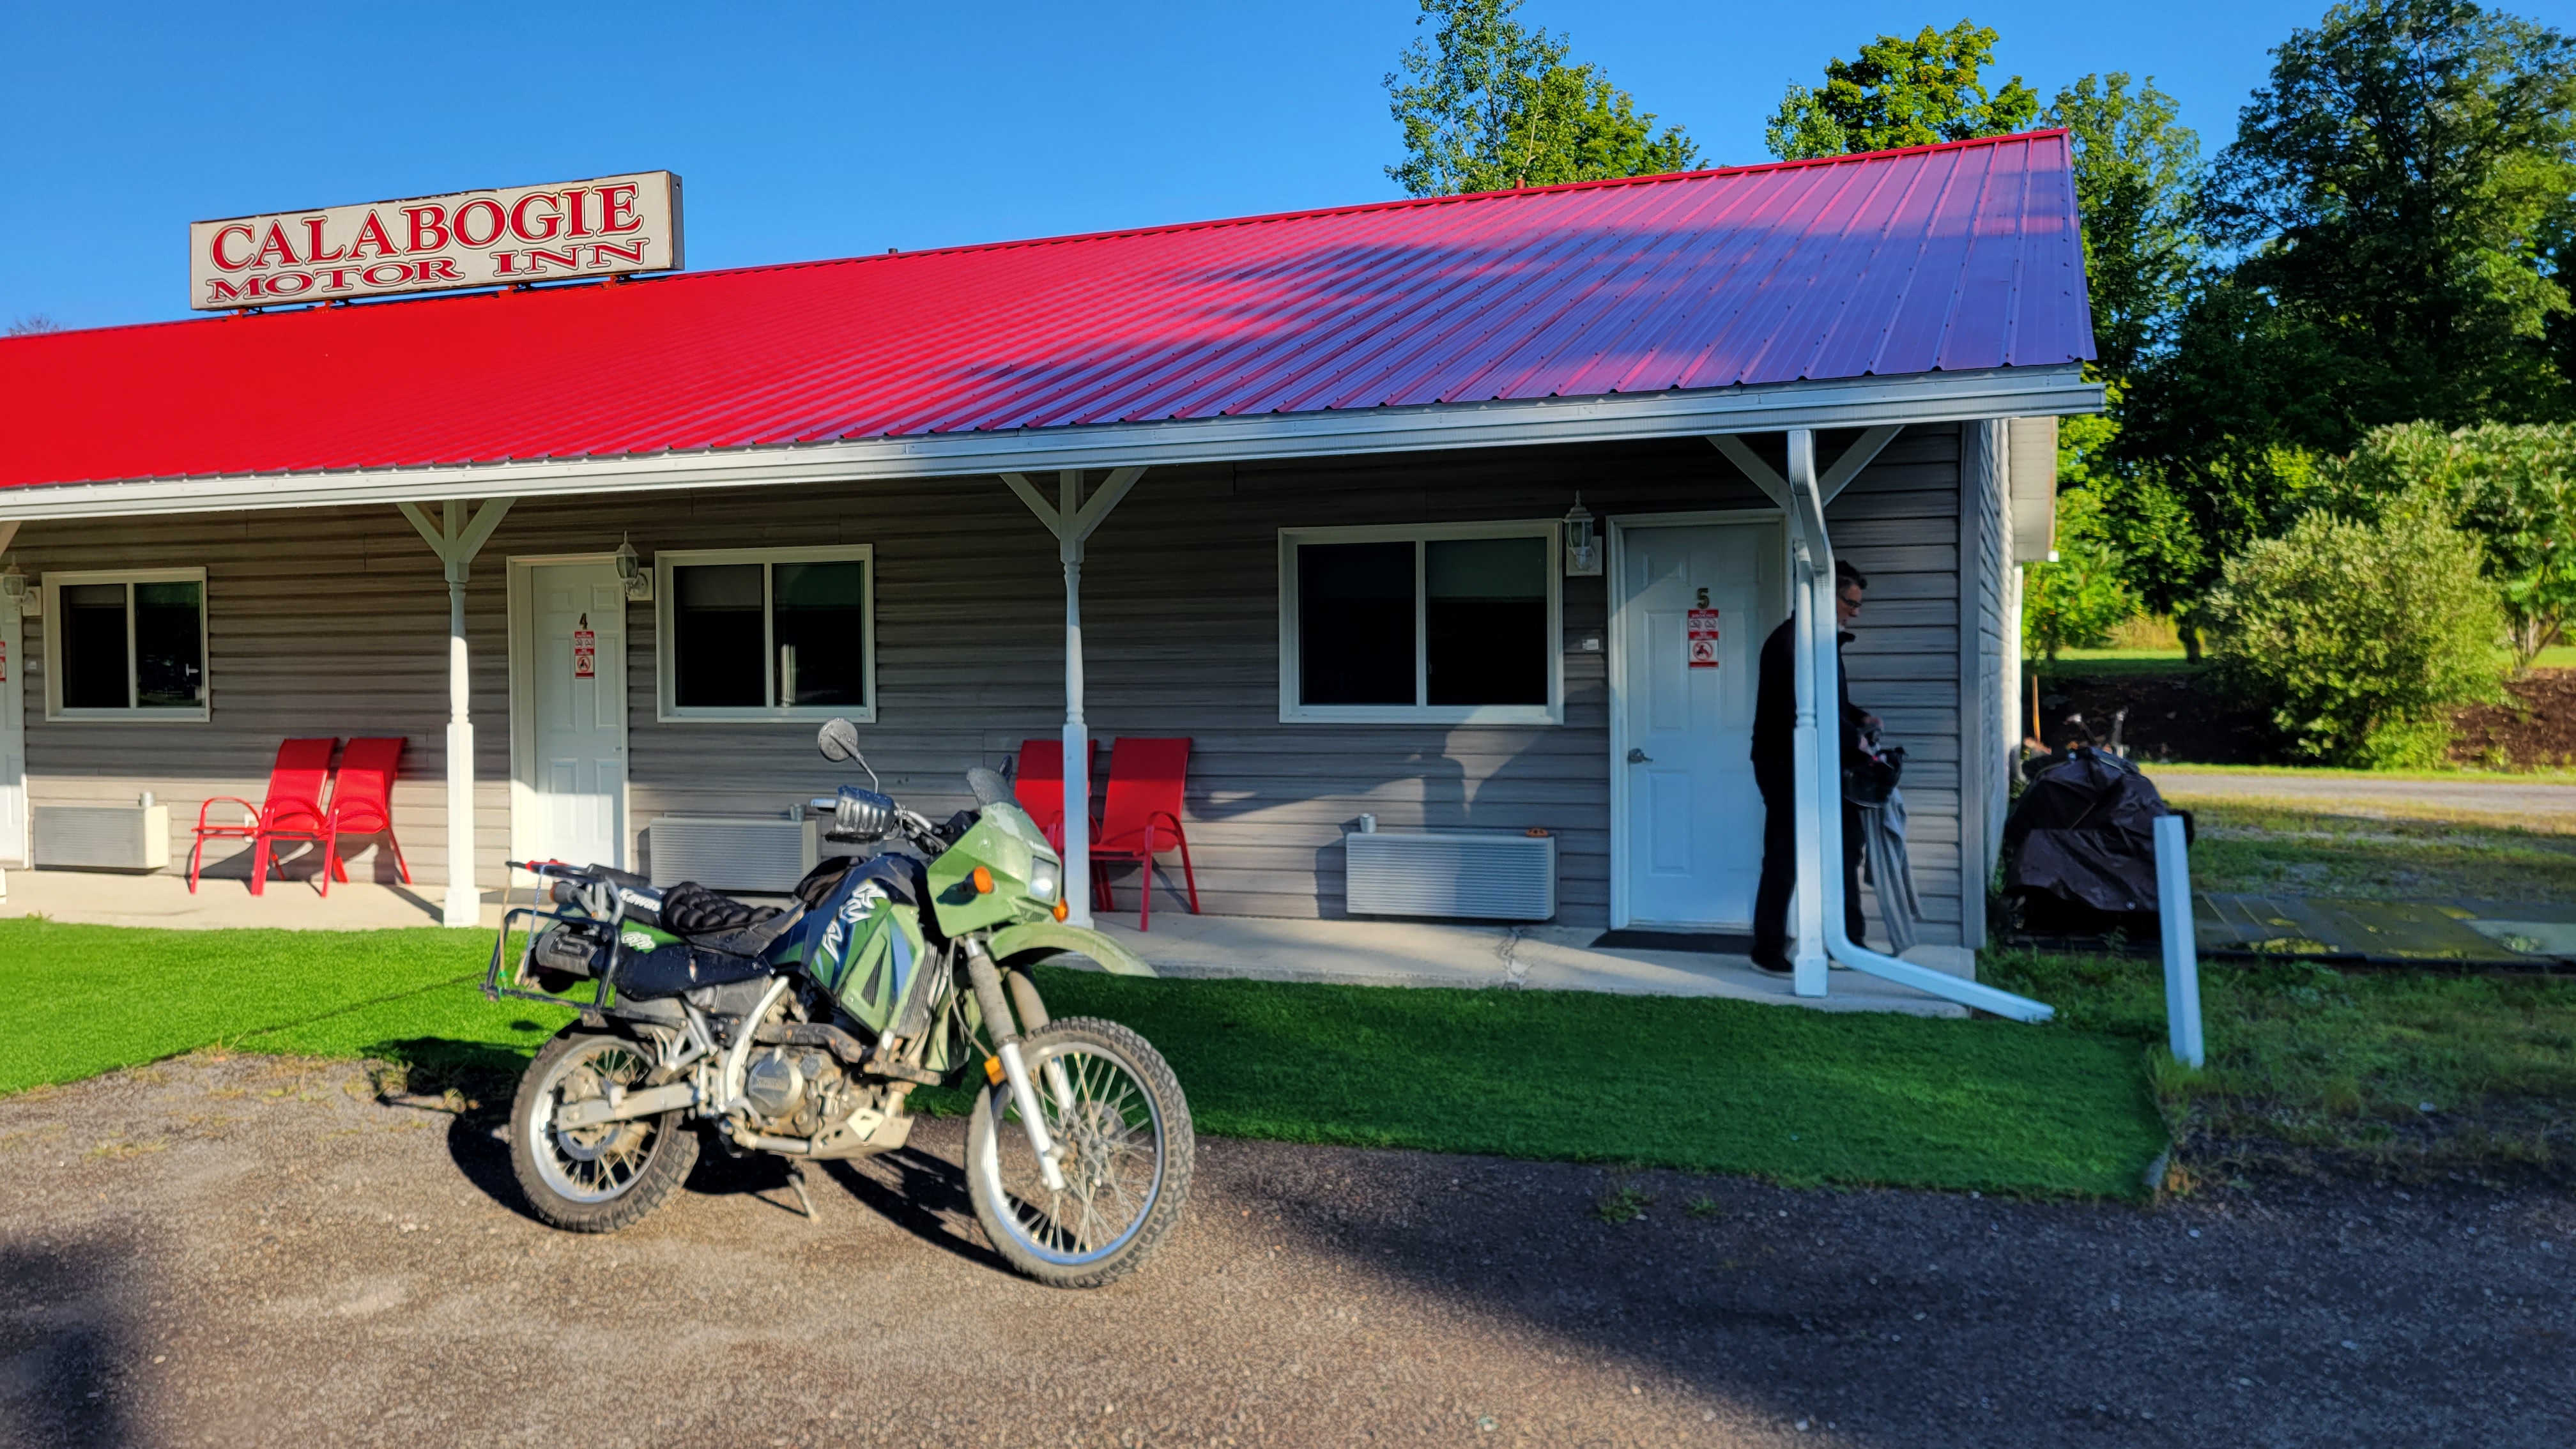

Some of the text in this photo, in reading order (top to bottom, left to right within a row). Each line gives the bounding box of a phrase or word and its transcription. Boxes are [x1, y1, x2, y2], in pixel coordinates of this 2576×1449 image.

[210, 182, 644, 272] CALABOGIE
[206, 238, 650, 303] MOTOR INN
[1697, 588, 1709, 609] 5
[579, 612, 588, 630] 4
